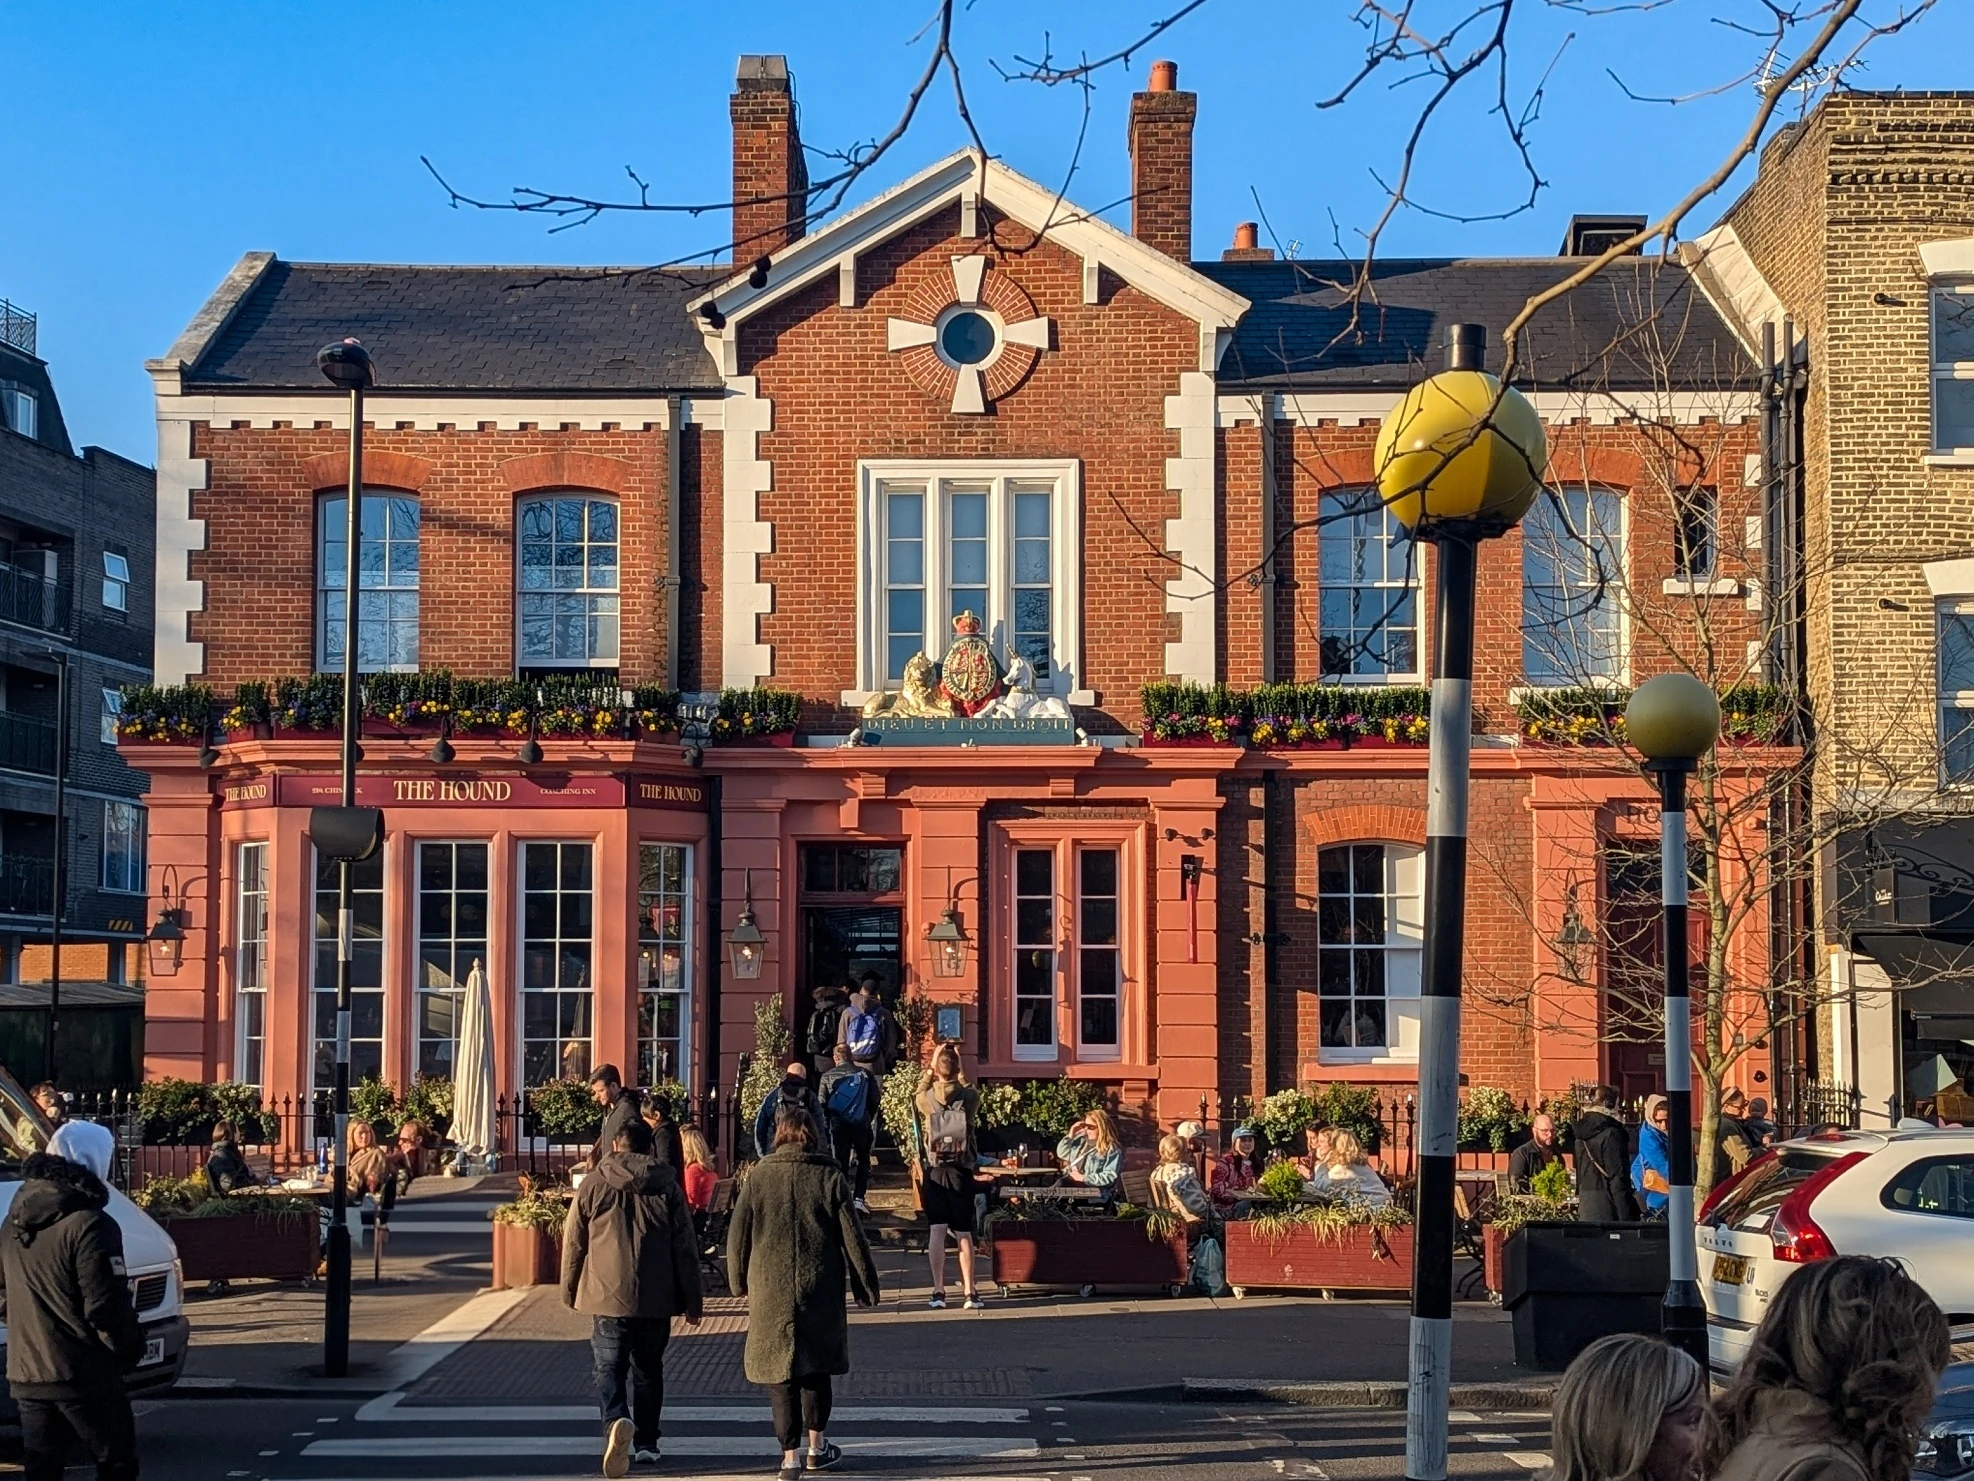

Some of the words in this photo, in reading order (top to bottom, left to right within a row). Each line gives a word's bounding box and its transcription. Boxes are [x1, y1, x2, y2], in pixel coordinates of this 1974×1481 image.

[867, 718, 915, 731] DIEU
[924, 718, 949, 731] ET
[959, 718, 1004, 731] MON
[1013, 718, 1072, 731] DROIT
[225, 786, 240, 802] THE
[240, 784, 267, 801] HOUND
[394, 780, 435, 801] THE
[439, 780, 511, 801] HOUND
[640, 783, 662, 799] THE
[664, 785, 702, 802] HOUND
